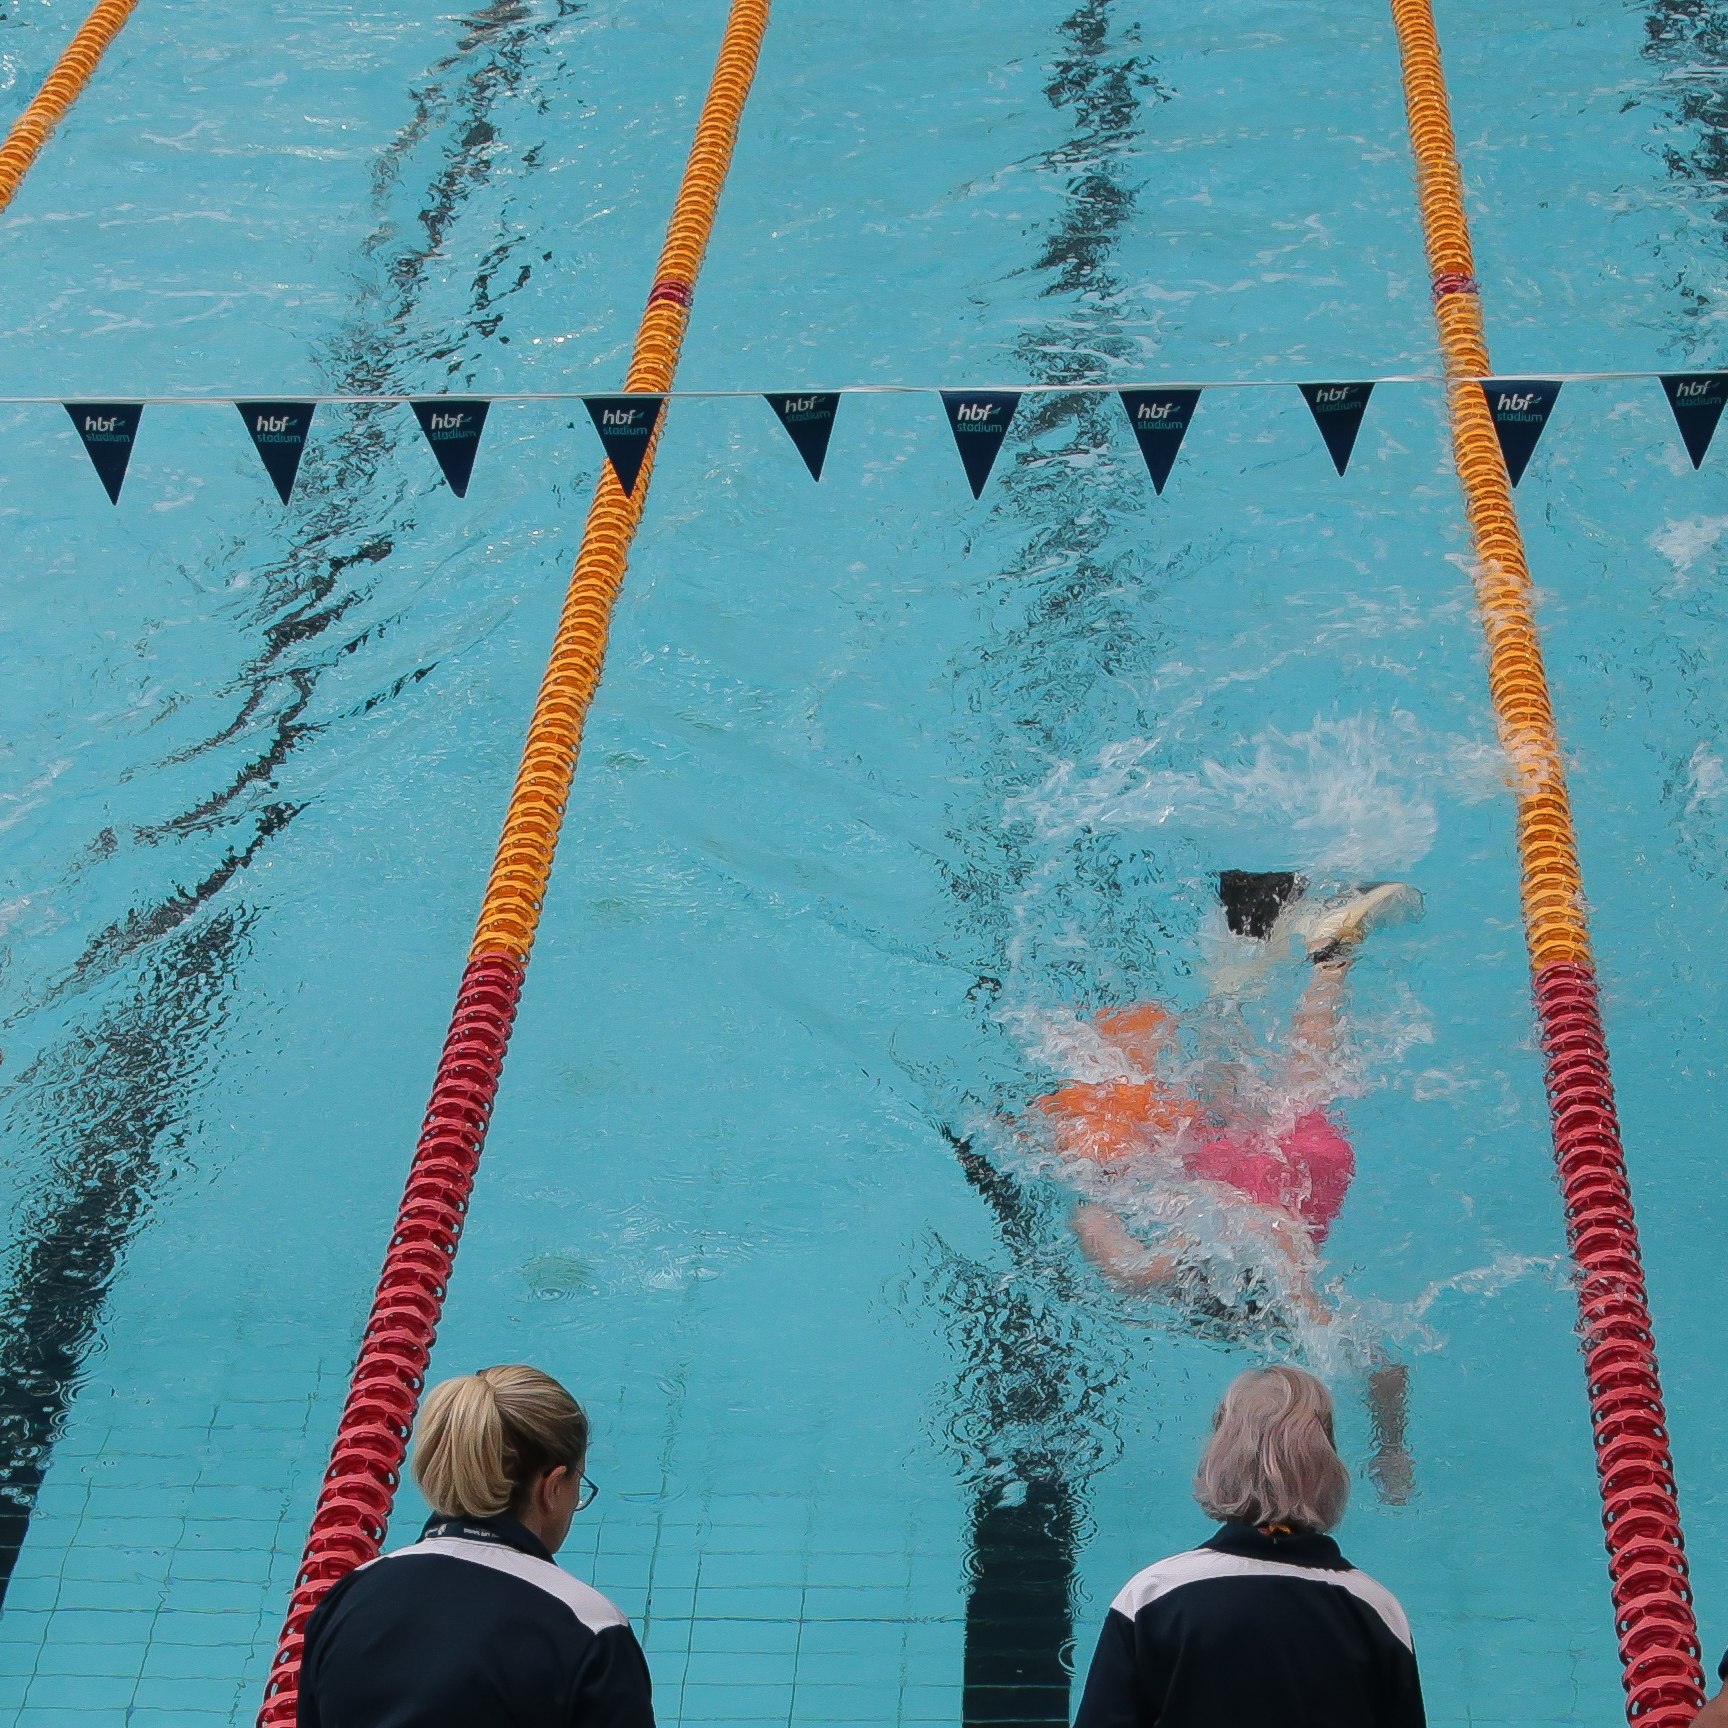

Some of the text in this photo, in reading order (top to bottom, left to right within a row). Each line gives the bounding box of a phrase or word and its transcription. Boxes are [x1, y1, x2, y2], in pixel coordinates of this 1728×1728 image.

[1316, 386, 1349, 403] hbf
[1676, 380, 1712, 398] hbf
[785, 396, 818, 413] hbf
[1497, 393, 1534, 411] hbf
[1676, 395, 1722, 407] stadium
[602, 409, 636, 425] hbf
[957, 403, 993, 421] hbf
[1138, 403, 1172, 420] hbf
[1497, 411, 1543, 423] stadium
[85, 416, 117, 432] hbf
[256, 416, 290, 433] hbf
[430, 413, 465, 430] hbf
[957, 422, 1003, 433] stadium
[1137, 420, 1183, 430] stadium
[85, 432, 130, 443] stadium
[257, 432, 301, 443] stadium
[431, 429, 477, 441] stadium
[603, 425, 648, 435] stadium
